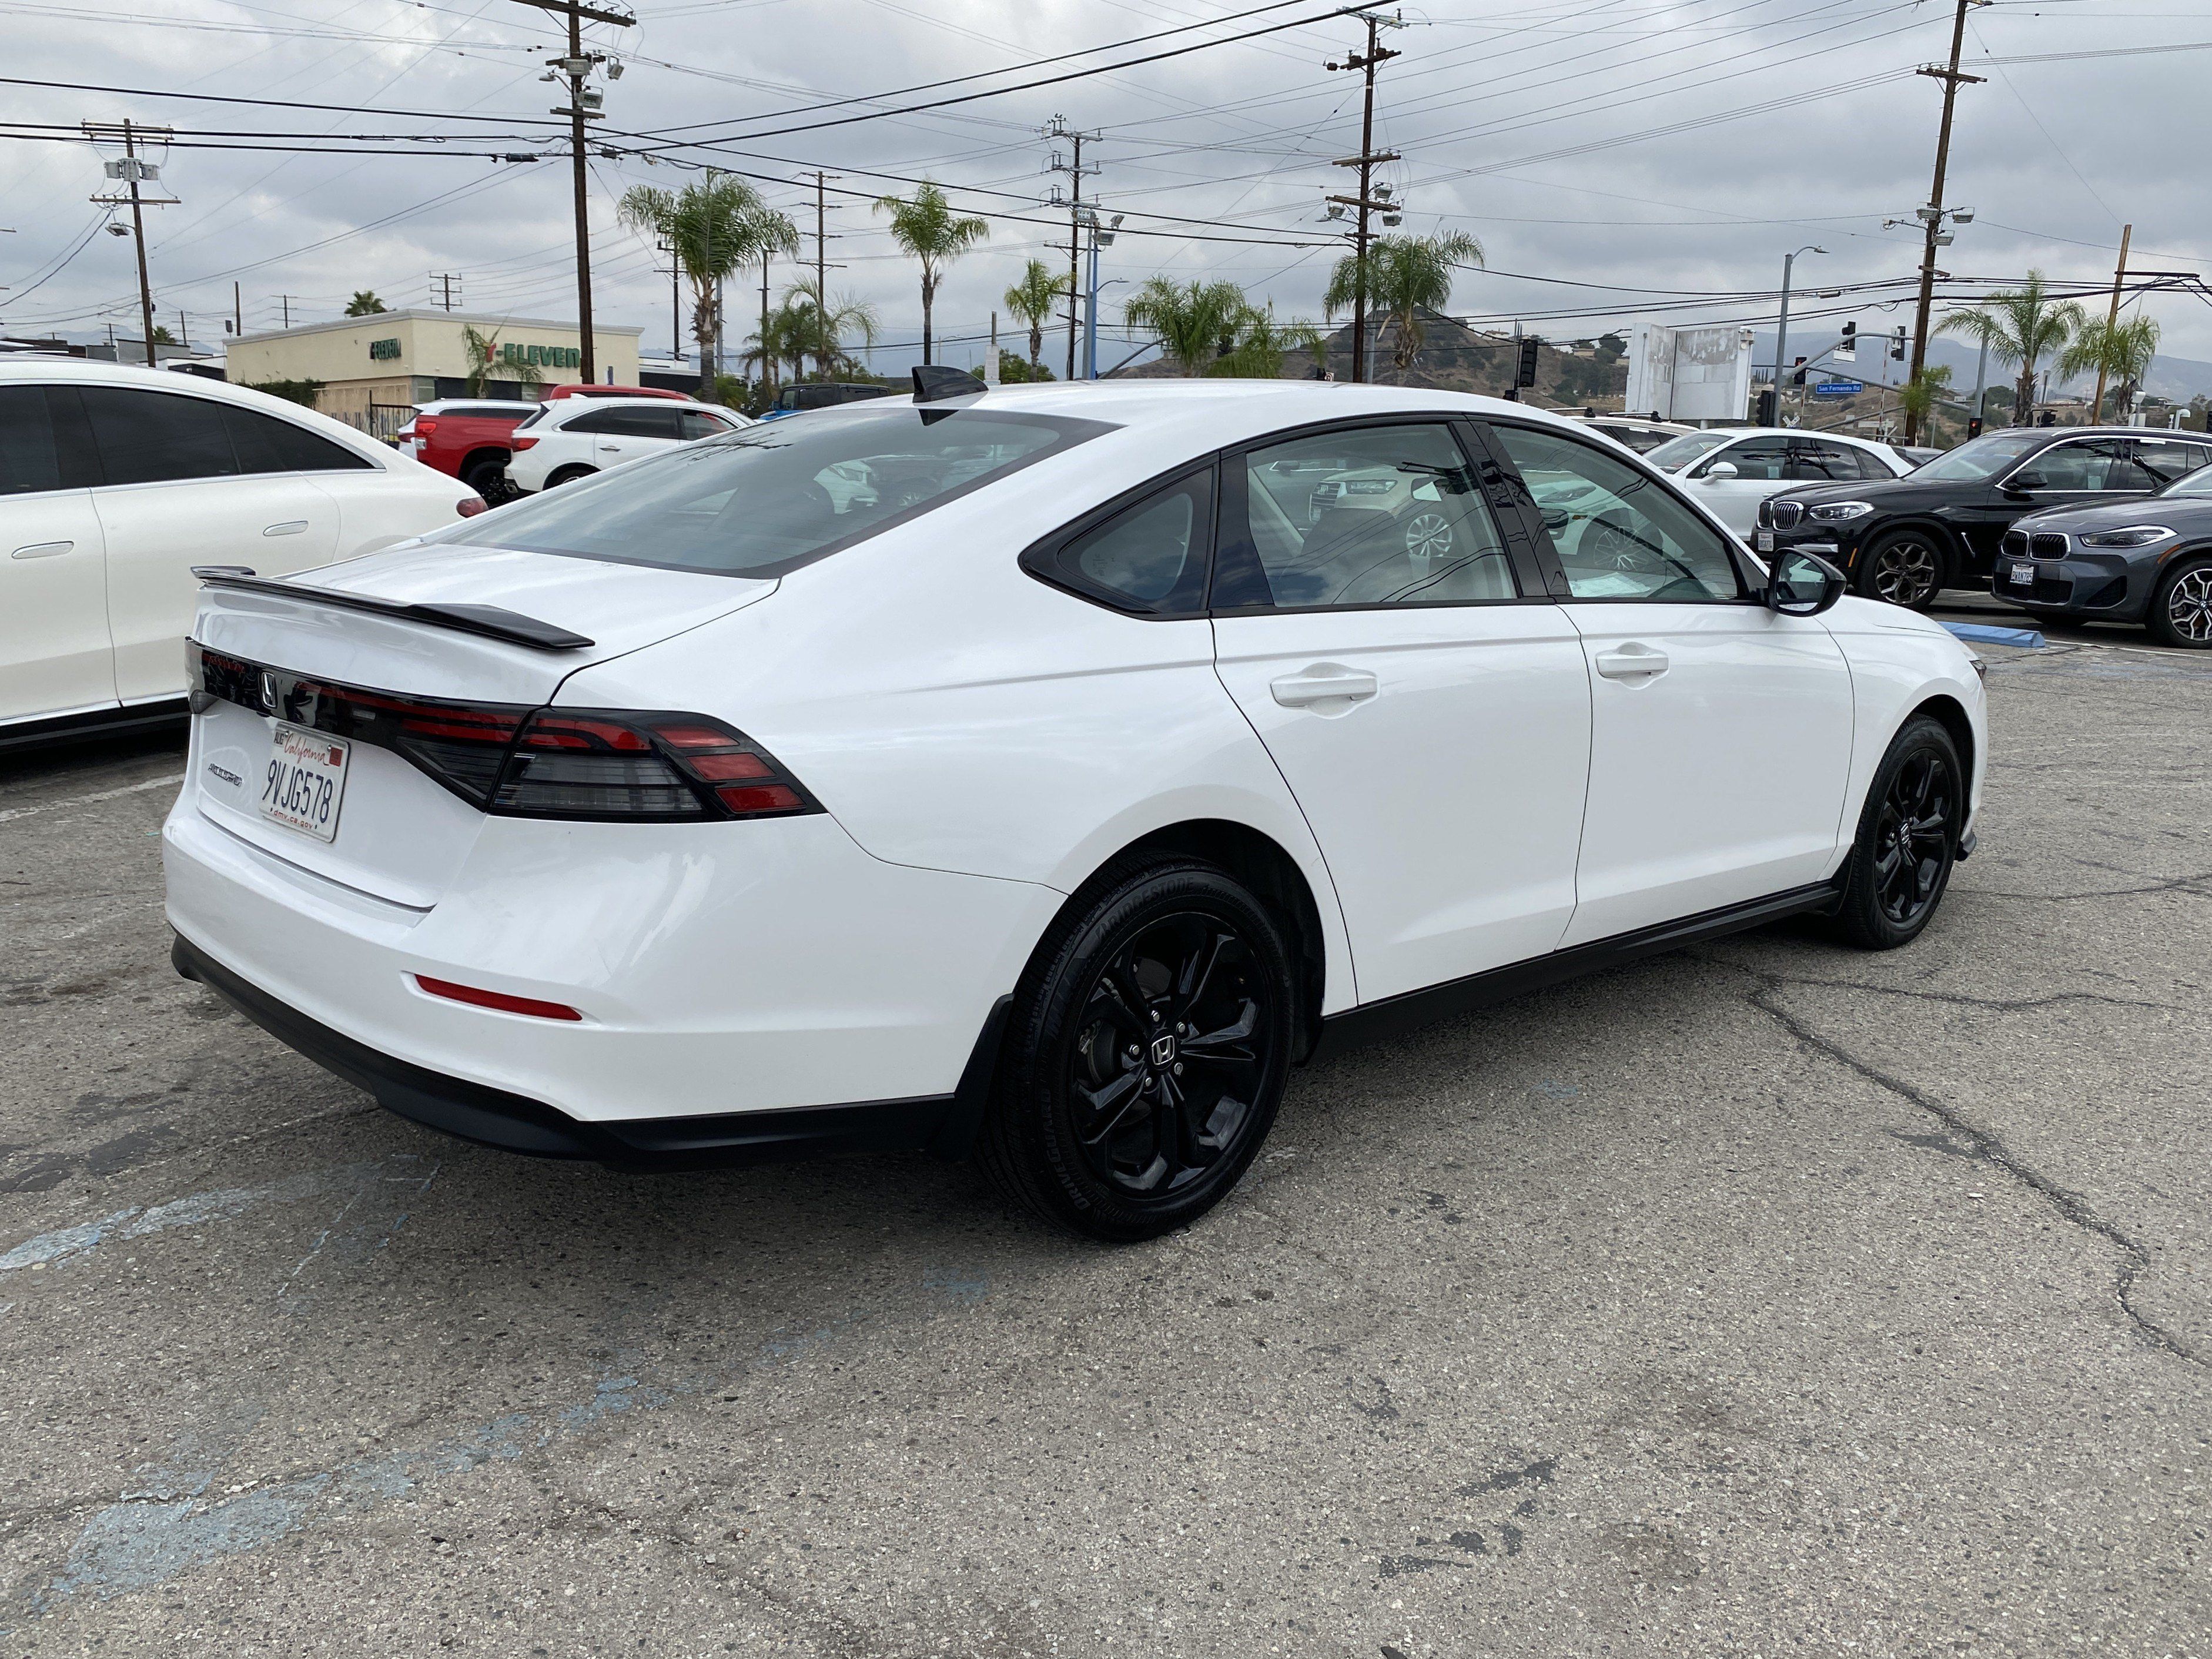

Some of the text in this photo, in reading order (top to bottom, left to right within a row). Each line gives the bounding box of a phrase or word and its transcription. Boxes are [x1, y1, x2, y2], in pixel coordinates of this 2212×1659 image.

[274, 731, 329, 766] AUG California
[262, 759, 333, 824] 9VJG578
[273, 810, 313, 829] dmv.ca.gov
